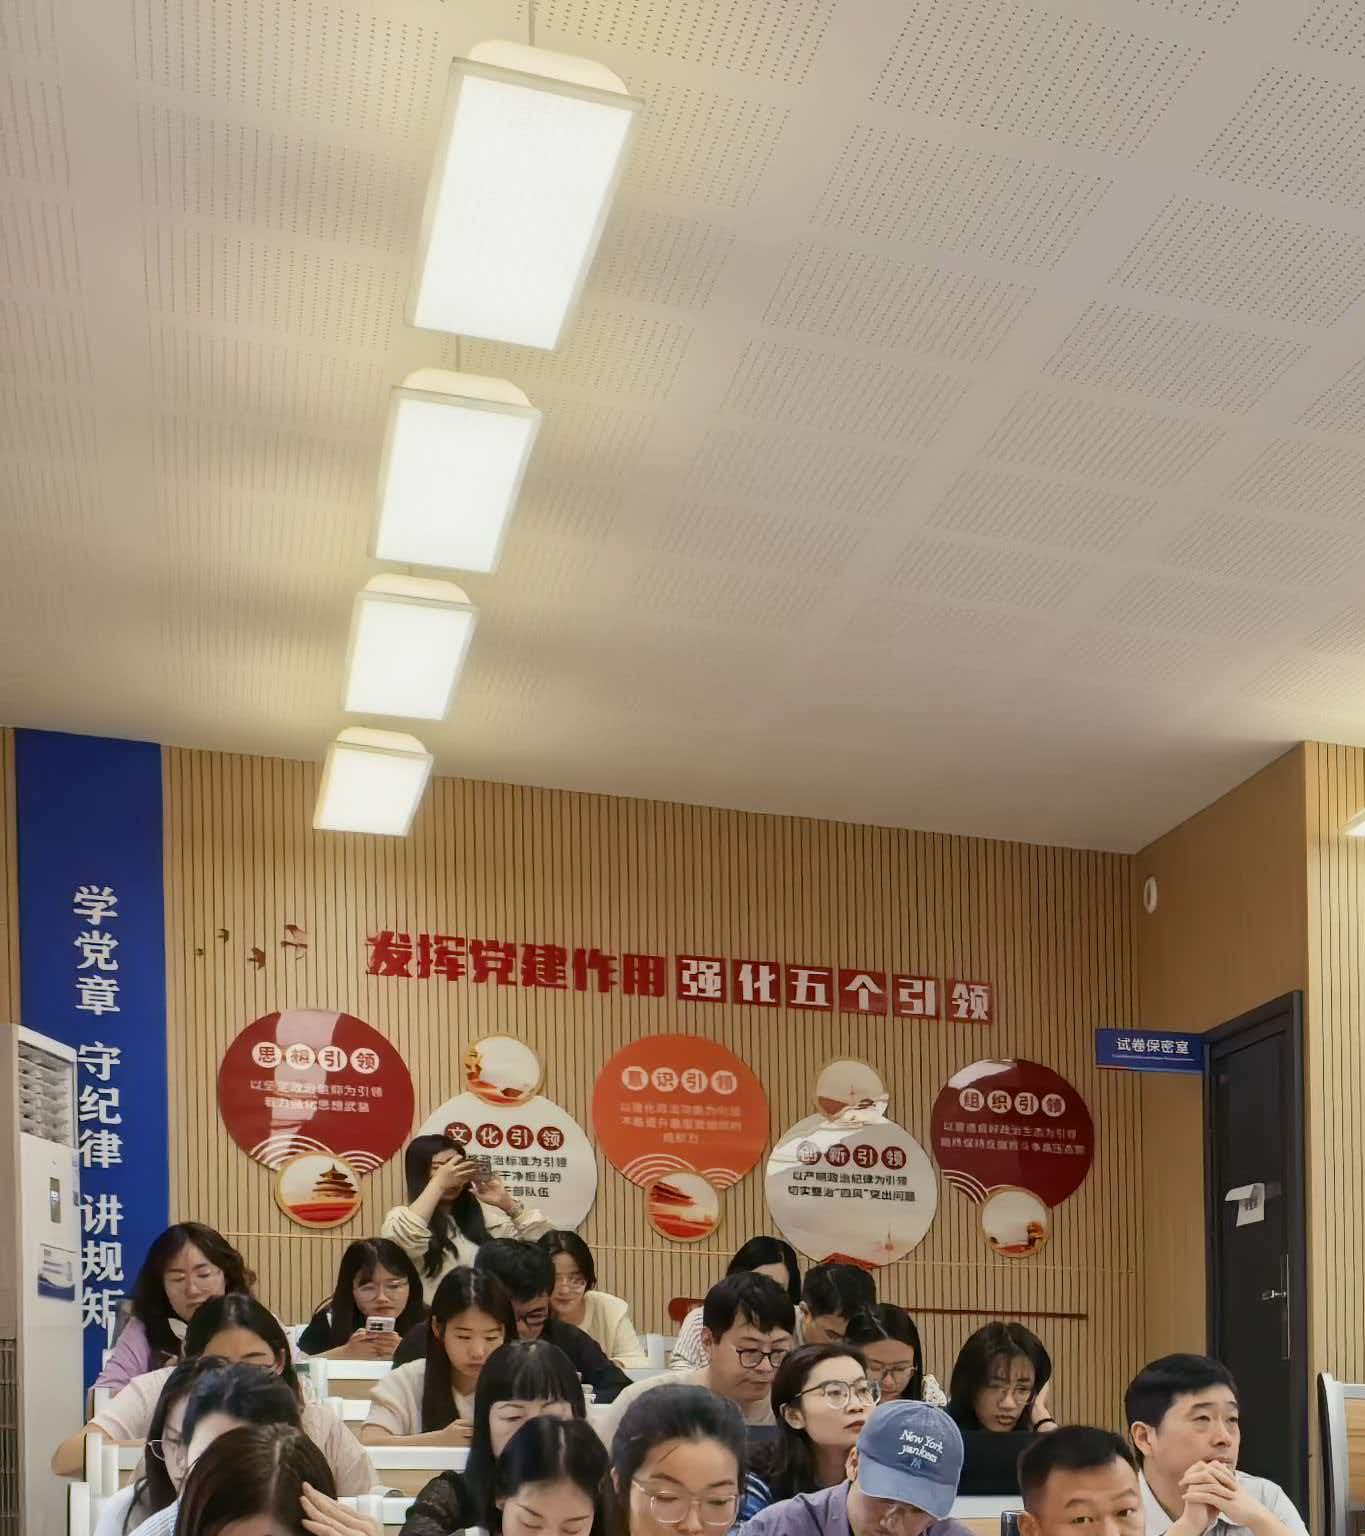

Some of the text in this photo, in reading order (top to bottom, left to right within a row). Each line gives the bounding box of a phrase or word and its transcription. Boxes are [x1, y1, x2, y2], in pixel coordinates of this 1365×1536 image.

[365, 931, 993, 1021] 发挥党建作用 强化五个引领
[257, 1045, 377, 1071] 思想引领
[1115, 1037, 1190, 1055] 试卷保密室
[73, 885, 125, 1329] 学党章 守纪律 讲规矩
[447, 1127, 562, 1149] 文化引领
[900, 1429, 943, 1454] New York
